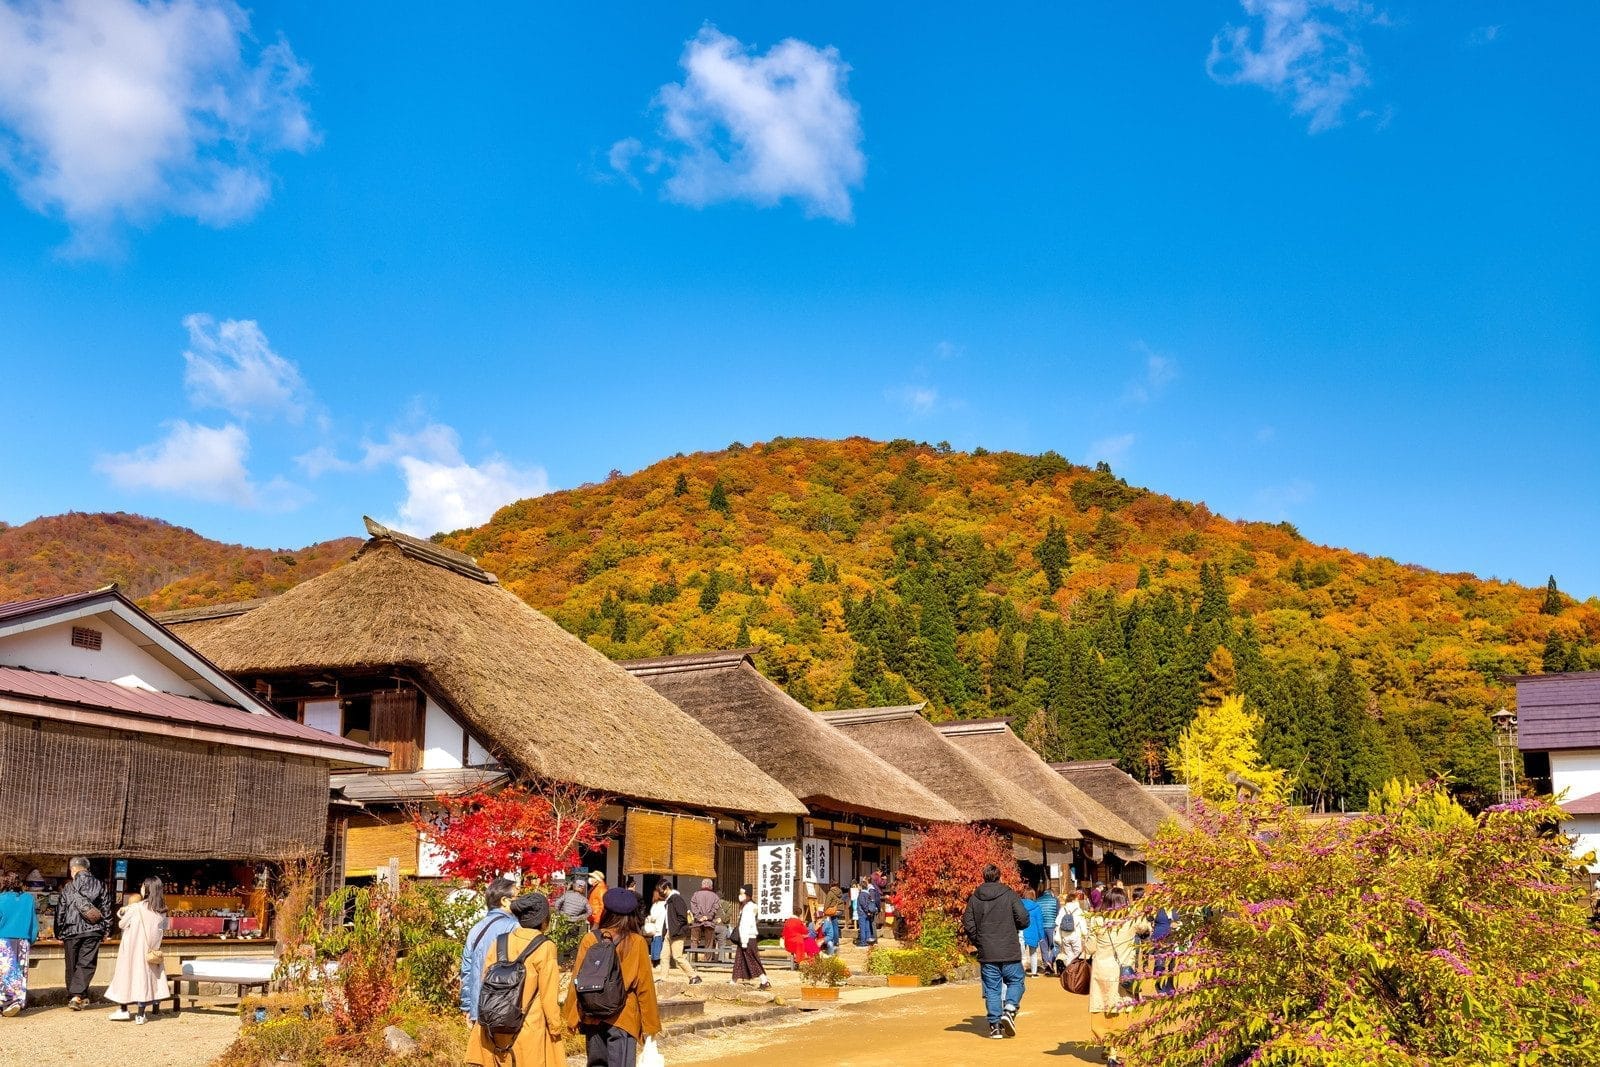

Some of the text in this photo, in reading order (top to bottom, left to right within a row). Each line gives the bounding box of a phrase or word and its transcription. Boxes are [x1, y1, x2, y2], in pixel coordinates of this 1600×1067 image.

[760, 889, 768, 915] 山本屋
[769, 846, 782, 914] くるみそば
